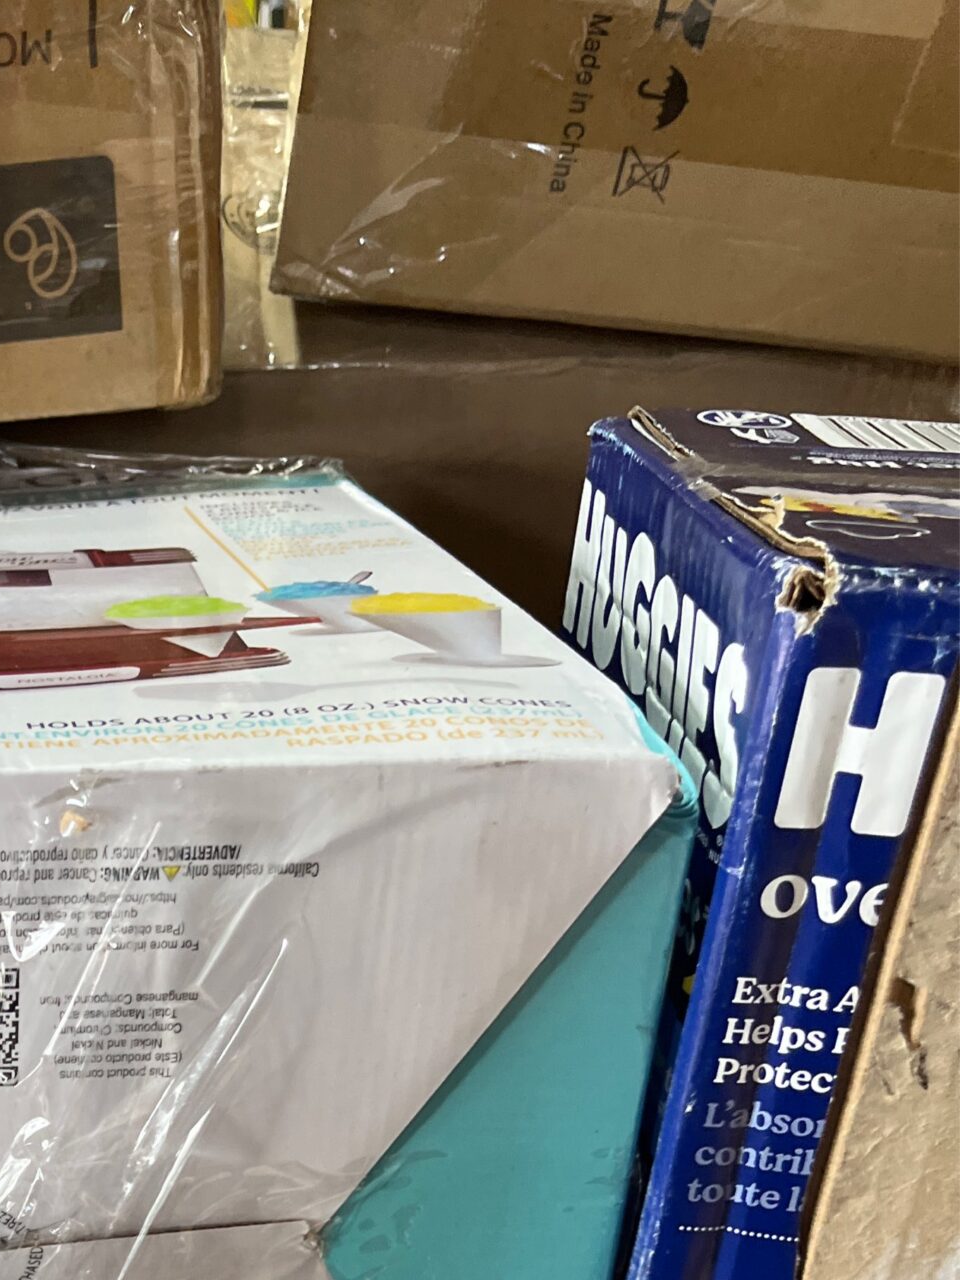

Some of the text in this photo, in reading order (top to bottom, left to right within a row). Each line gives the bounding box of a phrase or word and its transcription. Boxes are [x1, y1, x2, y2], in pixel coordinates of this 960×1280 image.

[549, 13, 613, 193] Made in China
[17, 672, 116, 684] NOSTALGIA
[26, 719, 125, 730] HOLDS
[134, 712, 231, 725] ABOUT
[241, 709, 275, 719] 20
[283, 707, 310, 716] (8
[383, 697, 469, 708] SNOW
[478, 698, 572, 708] CONES
[34, 725, 165, 740] ENVIRON
[176, 723, 208, 732] 20
[321, 713, 357, 723] DE
[368, 706, 461, 719] GLACE
[94, 720, 392, 746] APROXIMADAMENTE
[407, 718, 437, 729] 20
[446, 715, 548, 728] CONOS
[554, 718, 595, 728] DE
[287, 731, 428, 747] RASPADO
[496, 729, 540, 739] 237
[0, 847, 68, 865] reproductivo
[33, 869, 55, 884] and
[58, 867, 98, 883] Cancer
[213, 863, 264, 880] residents
[156, 922, 186, 935] (Para
[150, 940, 178, 950] more
[182, 939, 200, 951] For
[136, 990, 199, 1003] manganese
[731, 976, 829, 1012] Extra
[84, 1007, 145, 1020] Manganese
[107, 1037, 163, 1049] Nickel and
[721, 1016, 826, 1054] Helps
[104, 1050, 183, 1063] (Este producto
[107, 1065, 171, 1079] This product
[687, 1177, 780, 1210] toute
